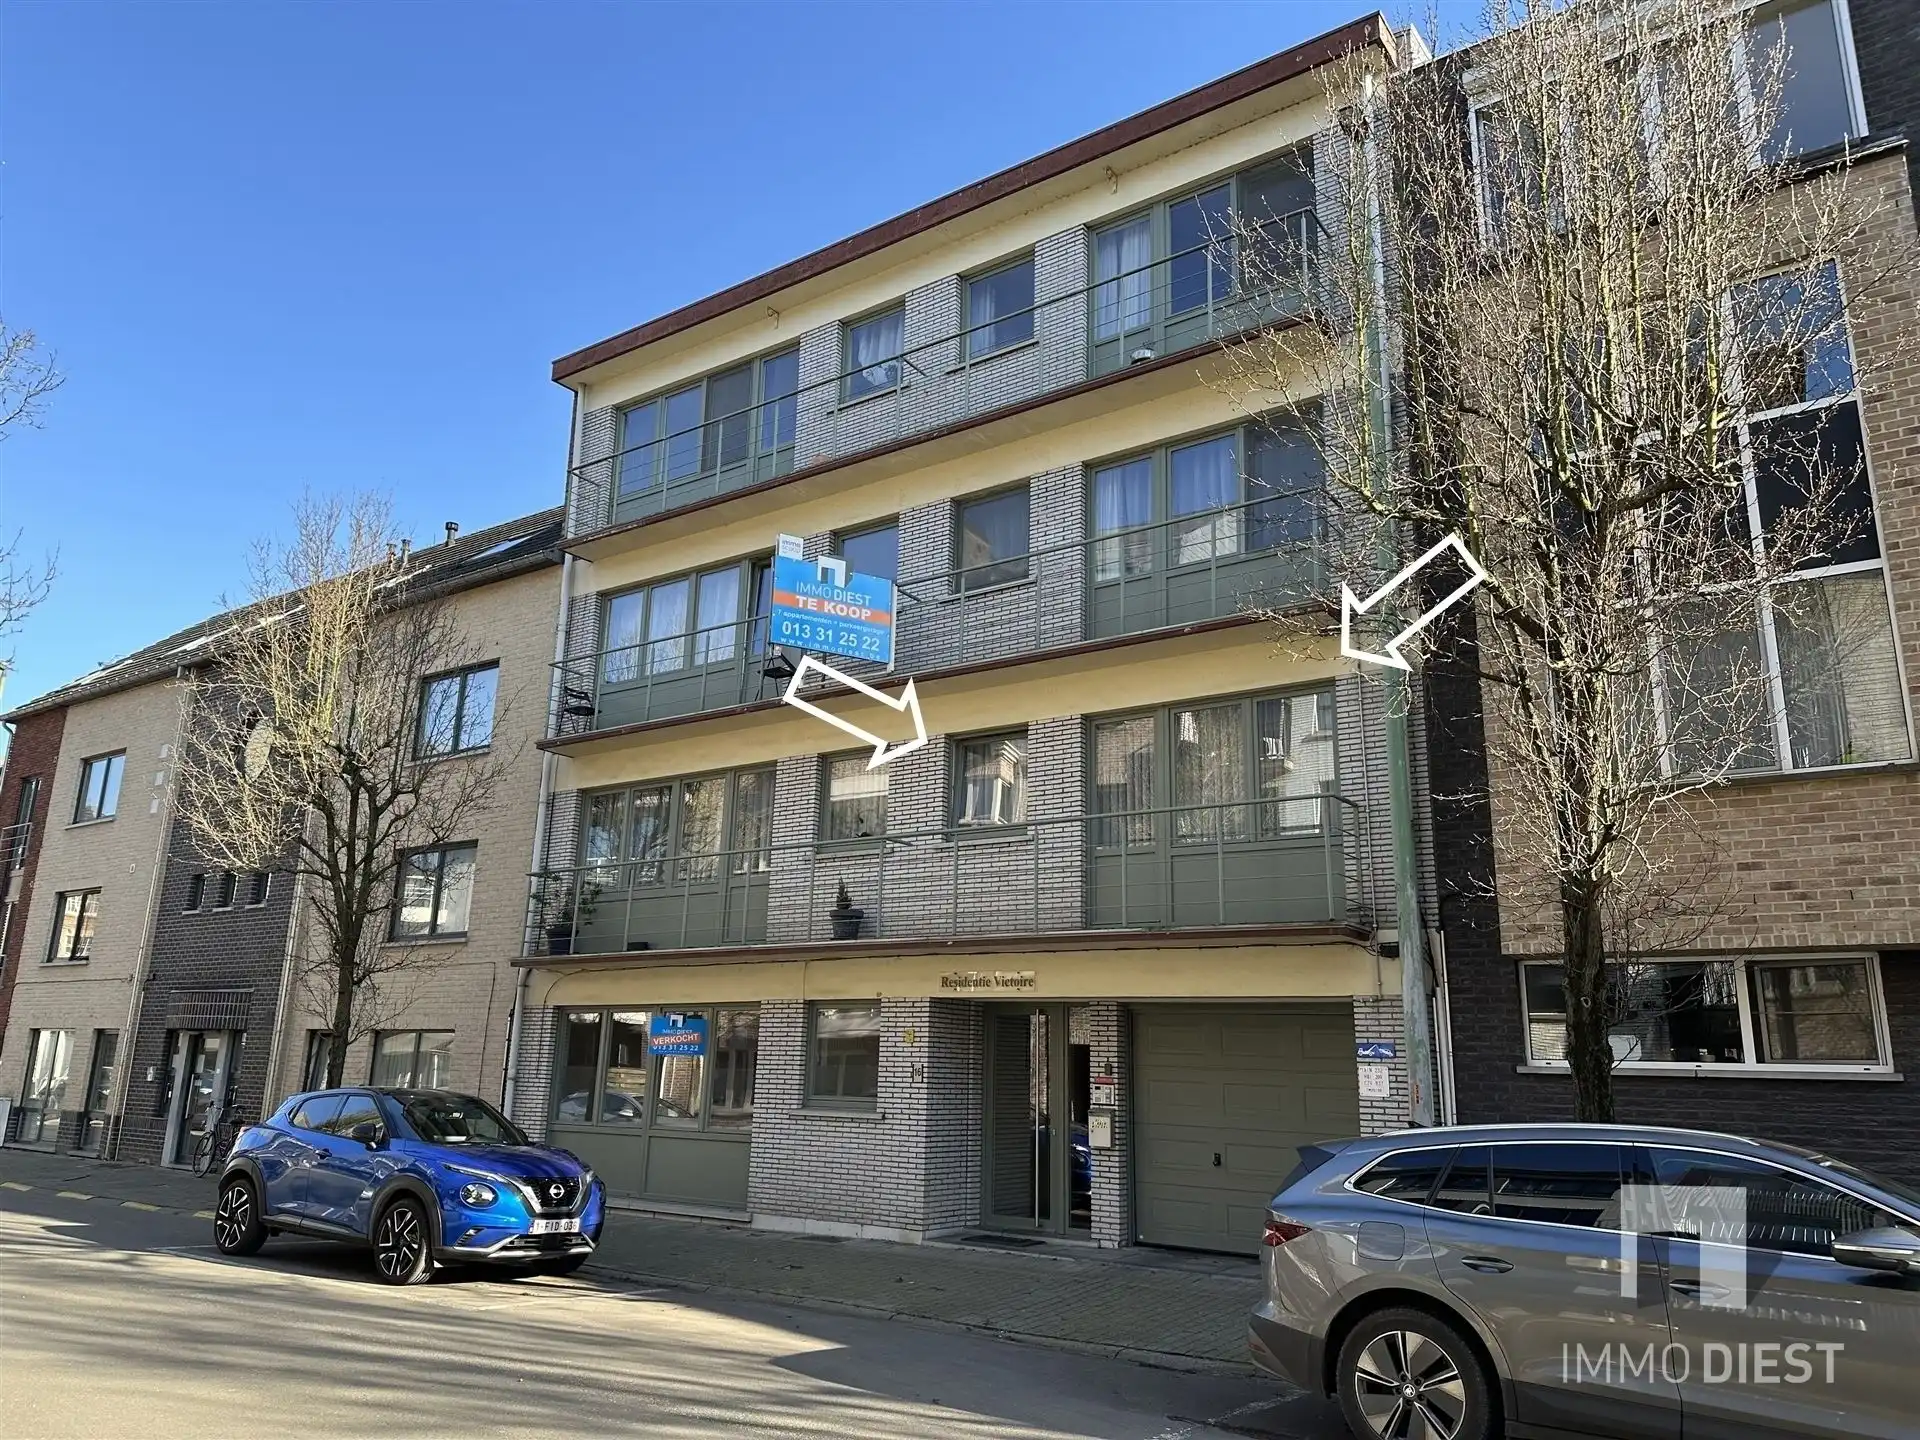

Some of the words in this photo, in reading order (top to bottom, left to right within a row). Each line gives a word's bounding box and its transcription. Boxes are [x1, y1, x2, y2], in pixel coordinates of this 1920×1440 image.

[796, 581, 831, 599] IMMO
[834, 589, 871, 606] DIEST
[795, 595, 817, 610] TE
[824, 601, 871, 620] KOOP
[782, 621, 811, 638] 013
[816, 627, 833, 642] 31
[839, 632, 857, 647] 25
[862, 636, 880, 652] 22
[780, 637, 880, 660] www.immodiest.be
[941, 976, 991, 988] Residentie
[994, 975, 1034, 987] Victoire
[653, 1033, 699, 1045] VERKOCHT
[914, 1067, 922, 1077] 16
